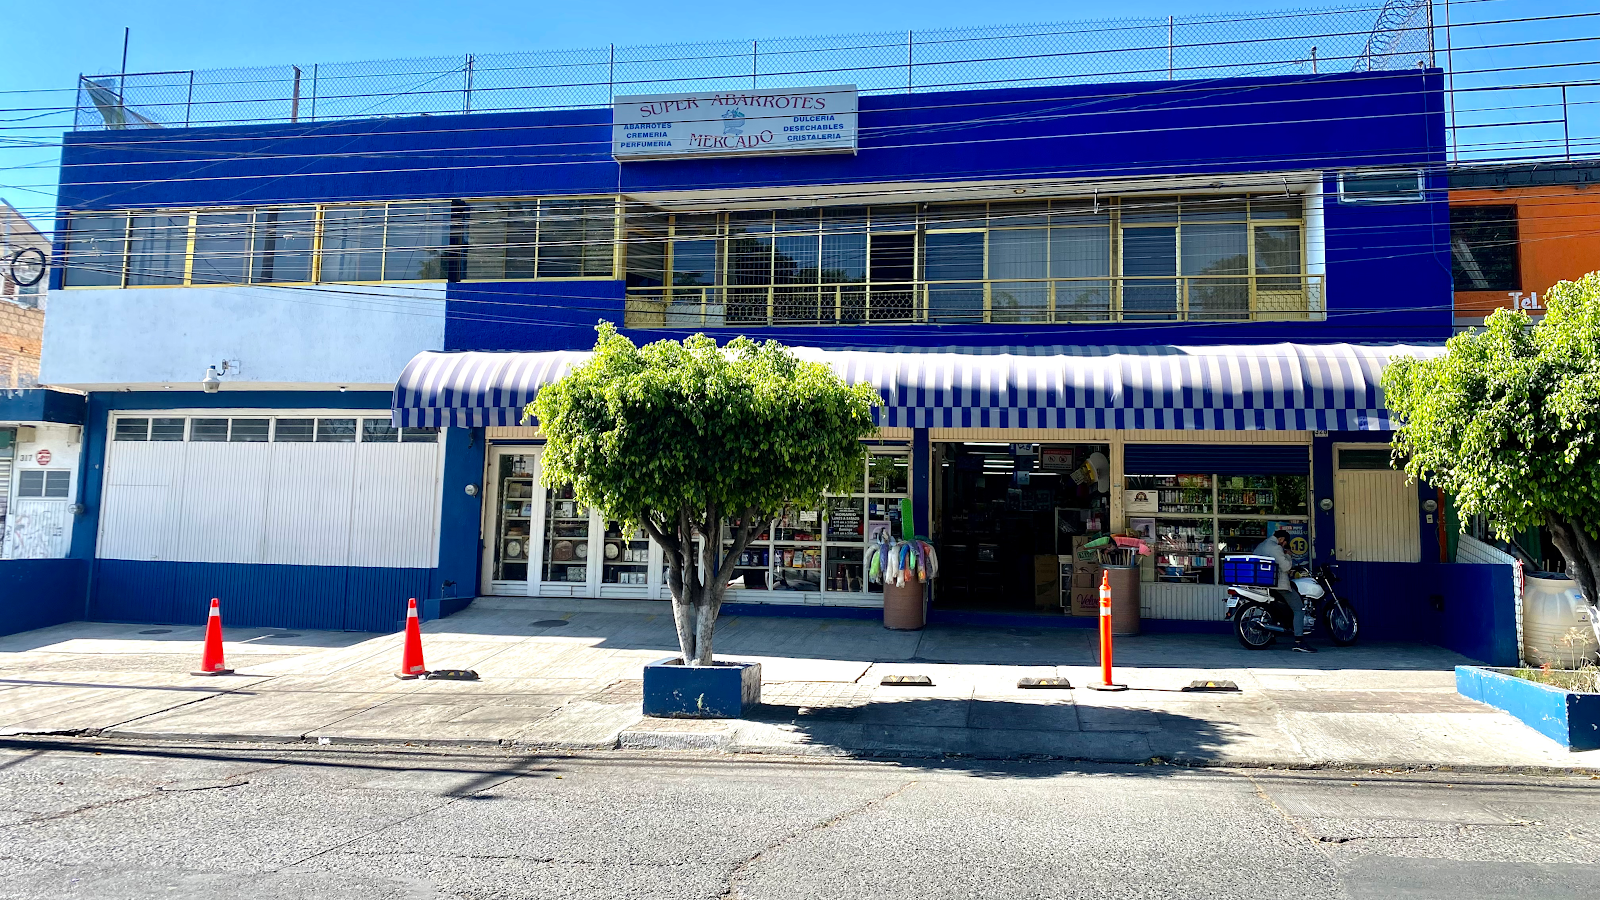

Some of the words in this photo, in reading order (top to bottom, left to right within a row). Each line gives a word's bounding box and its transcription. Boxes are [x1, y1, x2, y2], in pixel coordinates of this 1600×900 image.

[640, 97, 699, 118] SUPER
[711, 93, 826, 110] ABARROTES
[793, 115, 835, 123] DULCERIA
[623, 122, 672, 130] ABARROTES
[783, 123, 844, 132] DESECHABLES
[626, 131, 668, 139] CREMERIA
[689, 129, 773, 149] MERCADO
[787, 133, 842, 142] CRISTALERIA
[1508, 291, 1542, 309] Tel.
[20, 454, 33, 462] 317
[1077, 593, 1099, 605] Velve
